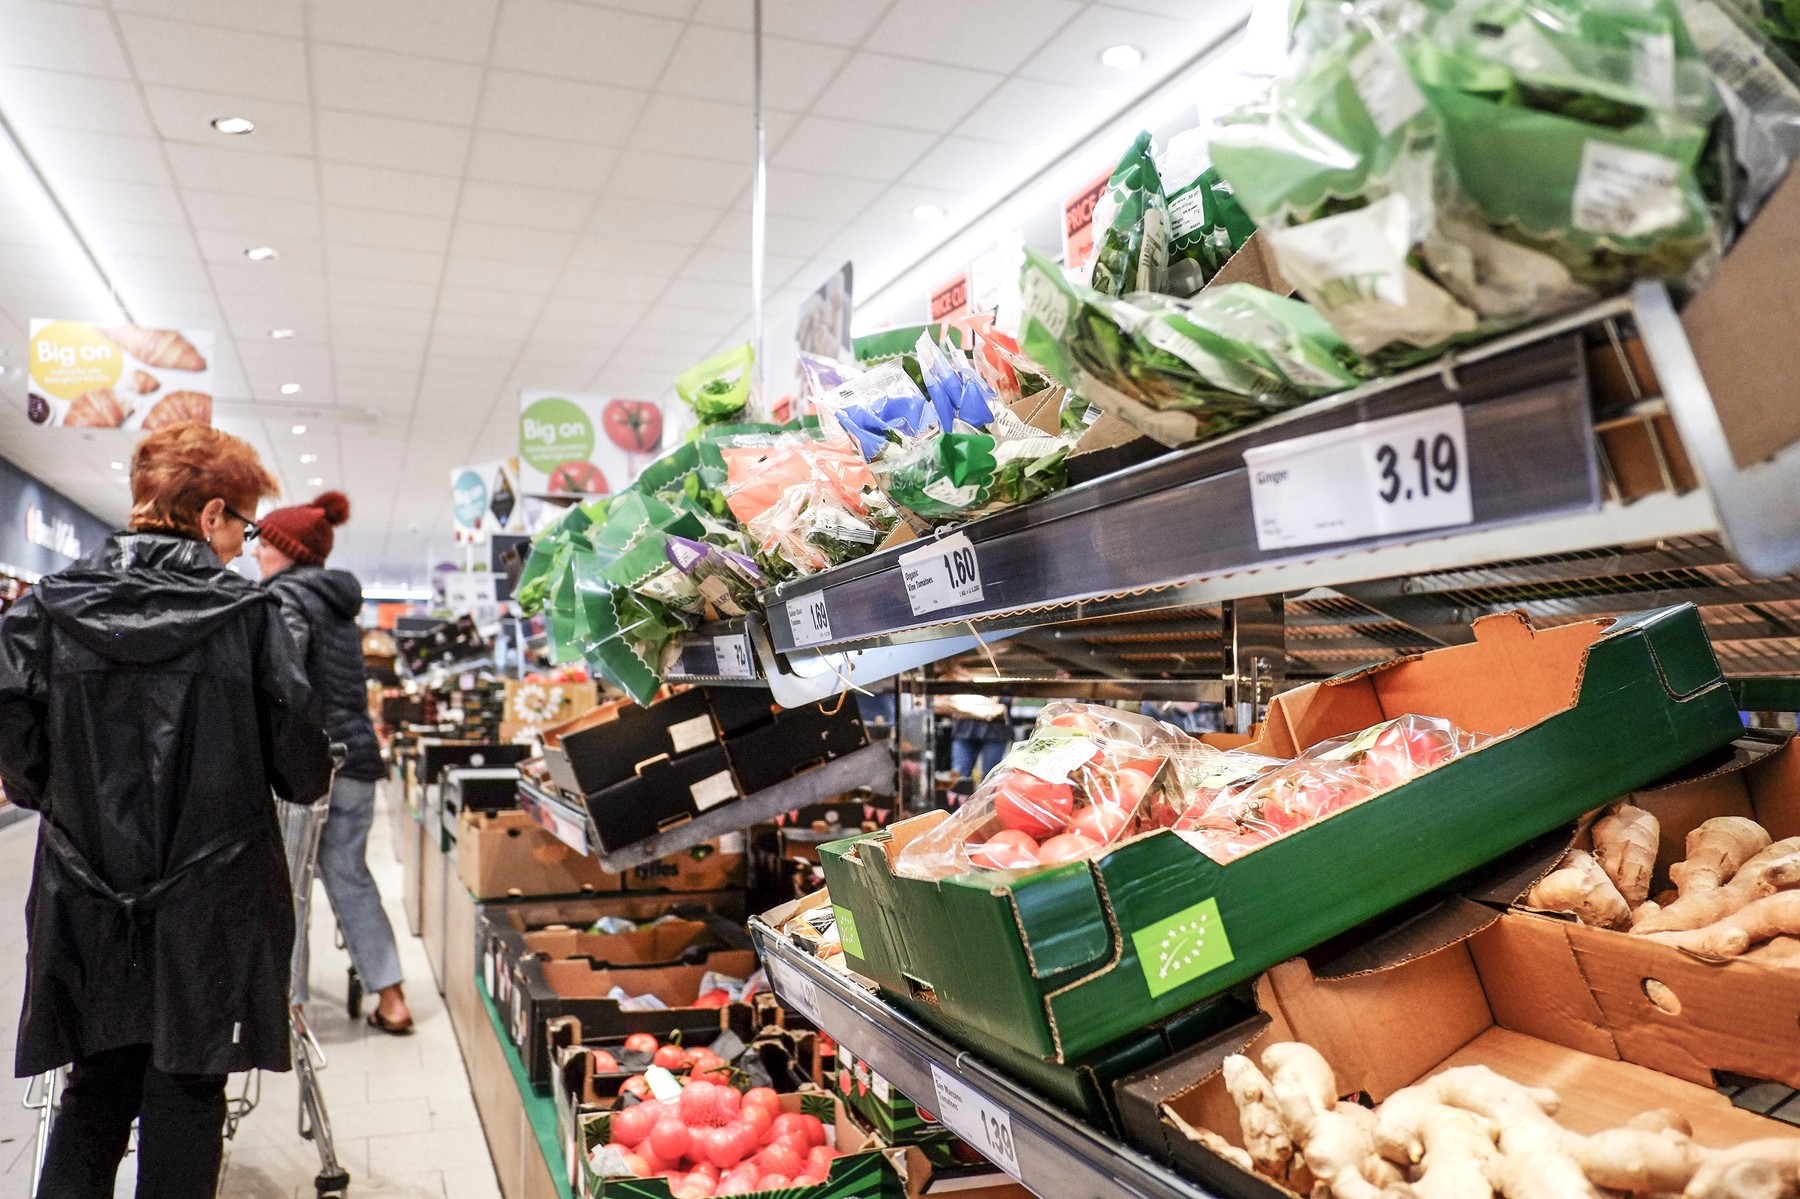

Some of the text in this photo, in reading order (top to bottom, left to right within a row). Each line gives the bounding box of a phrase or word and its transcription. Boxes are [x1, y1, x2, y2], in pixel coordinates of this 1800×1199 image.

[37, 340, 112, 368] Big on
[523, 418, 586, 444] Big on
[1256, 469, 1288, 485] Ginger
[1376, 432, 1459, 503] 3.19
[905, 568, 919, 581] Organic
[943, 546, 976, 589] 1.60
[810, 601, 828, 630] 1.69
[981, 1109, 1014, 1162] 1.39
